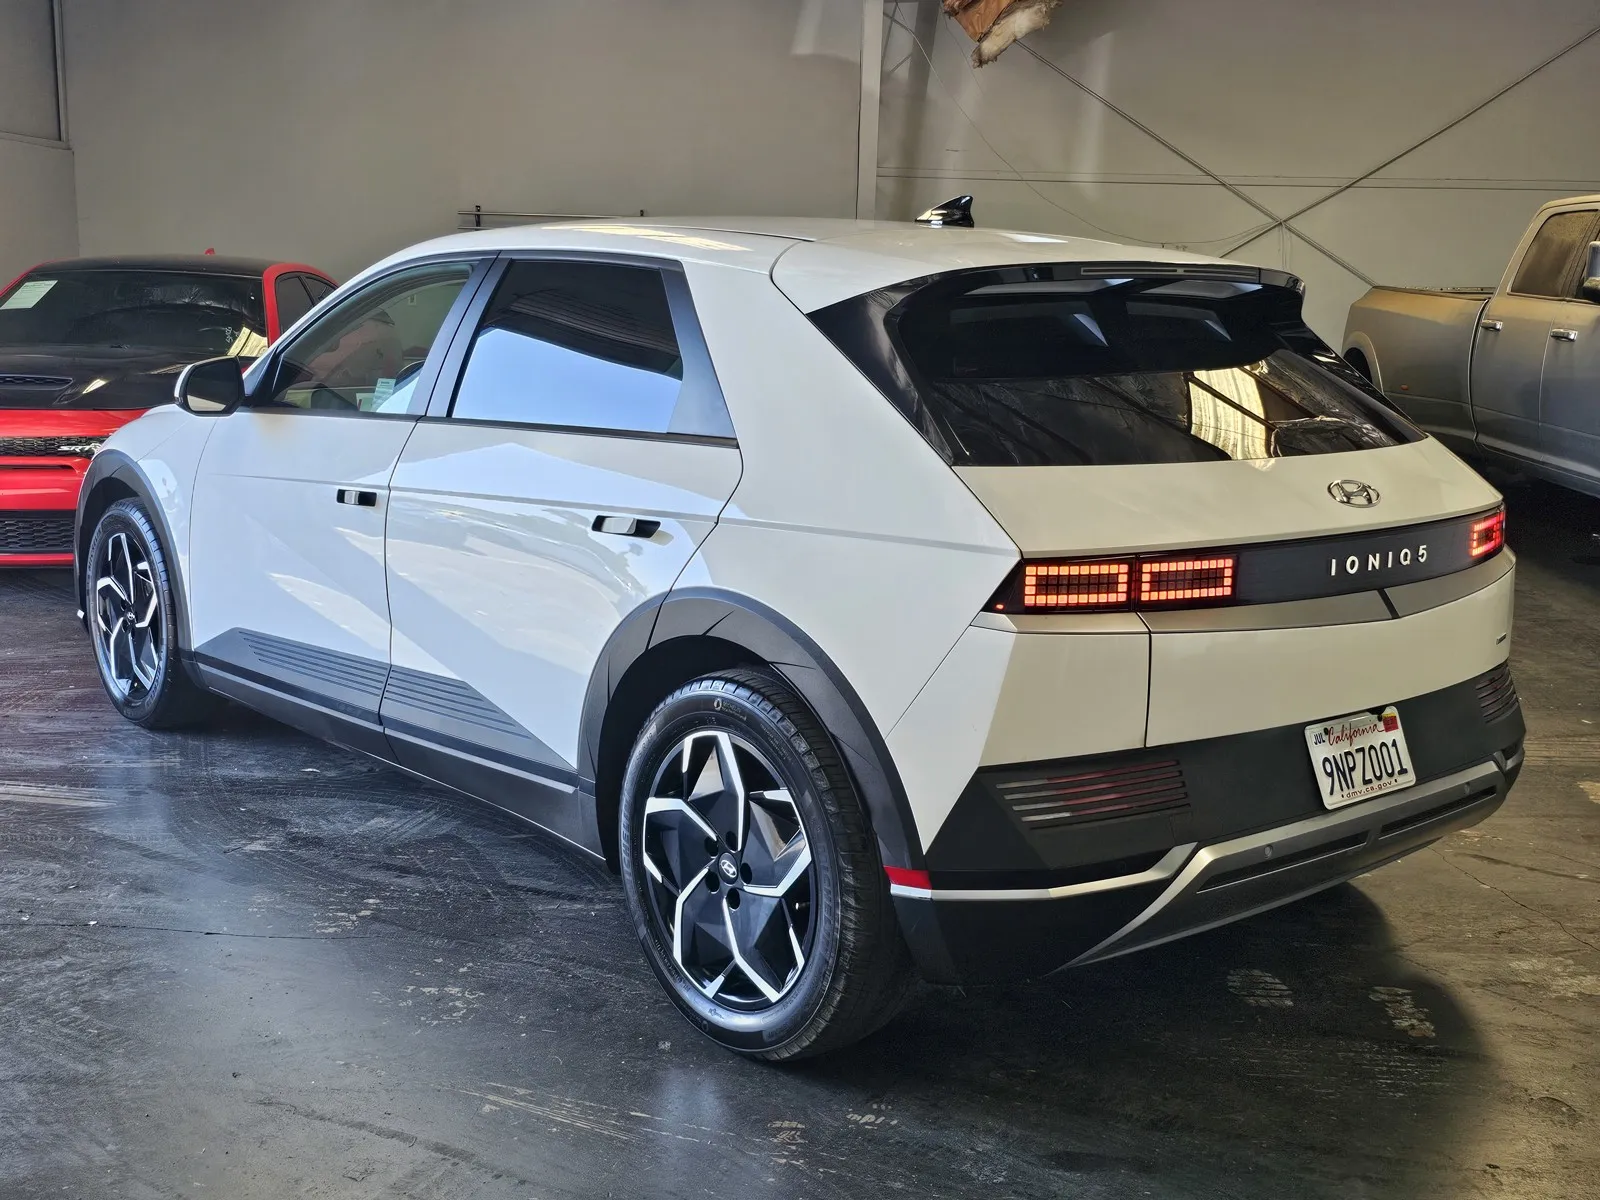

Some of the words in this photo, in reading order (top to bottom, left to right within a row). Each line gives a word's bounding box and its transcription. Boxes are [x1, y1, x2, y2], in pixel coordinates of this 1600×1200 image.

[1313, 731, 1326, 745] JUL
[1327, 719, 1385, 747] California
[1321, 738, 1409, 796] 9NPZ001
[1346, 780, 1392, 799] dmv.ca.gov
